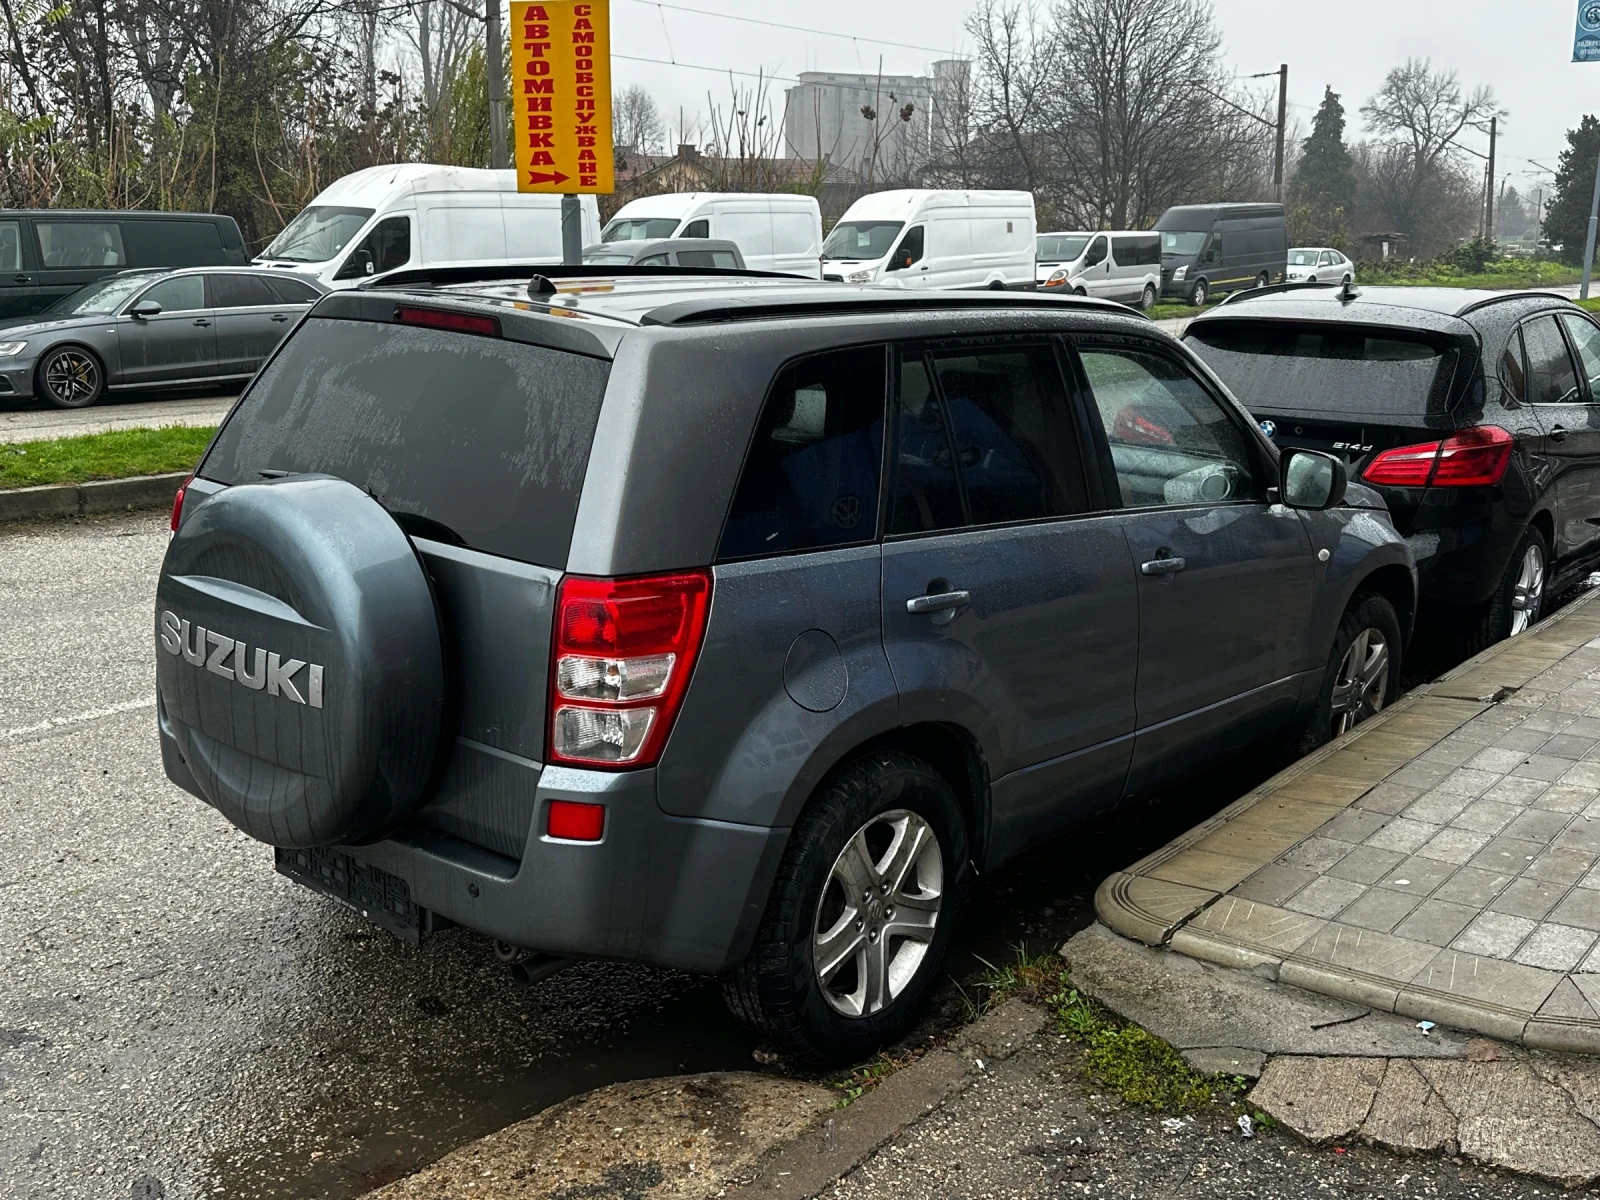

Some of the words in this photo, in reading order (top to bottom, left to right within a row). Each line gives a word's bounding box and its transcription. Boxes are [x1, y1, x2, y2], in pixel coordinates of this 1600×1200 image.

[524, 6, 555, 166] АВТОМИВКА
[572, 5, 597, 186] САМООБСЛУЖВАНЕ
[160, 610, 324, 709] SUZUKI
